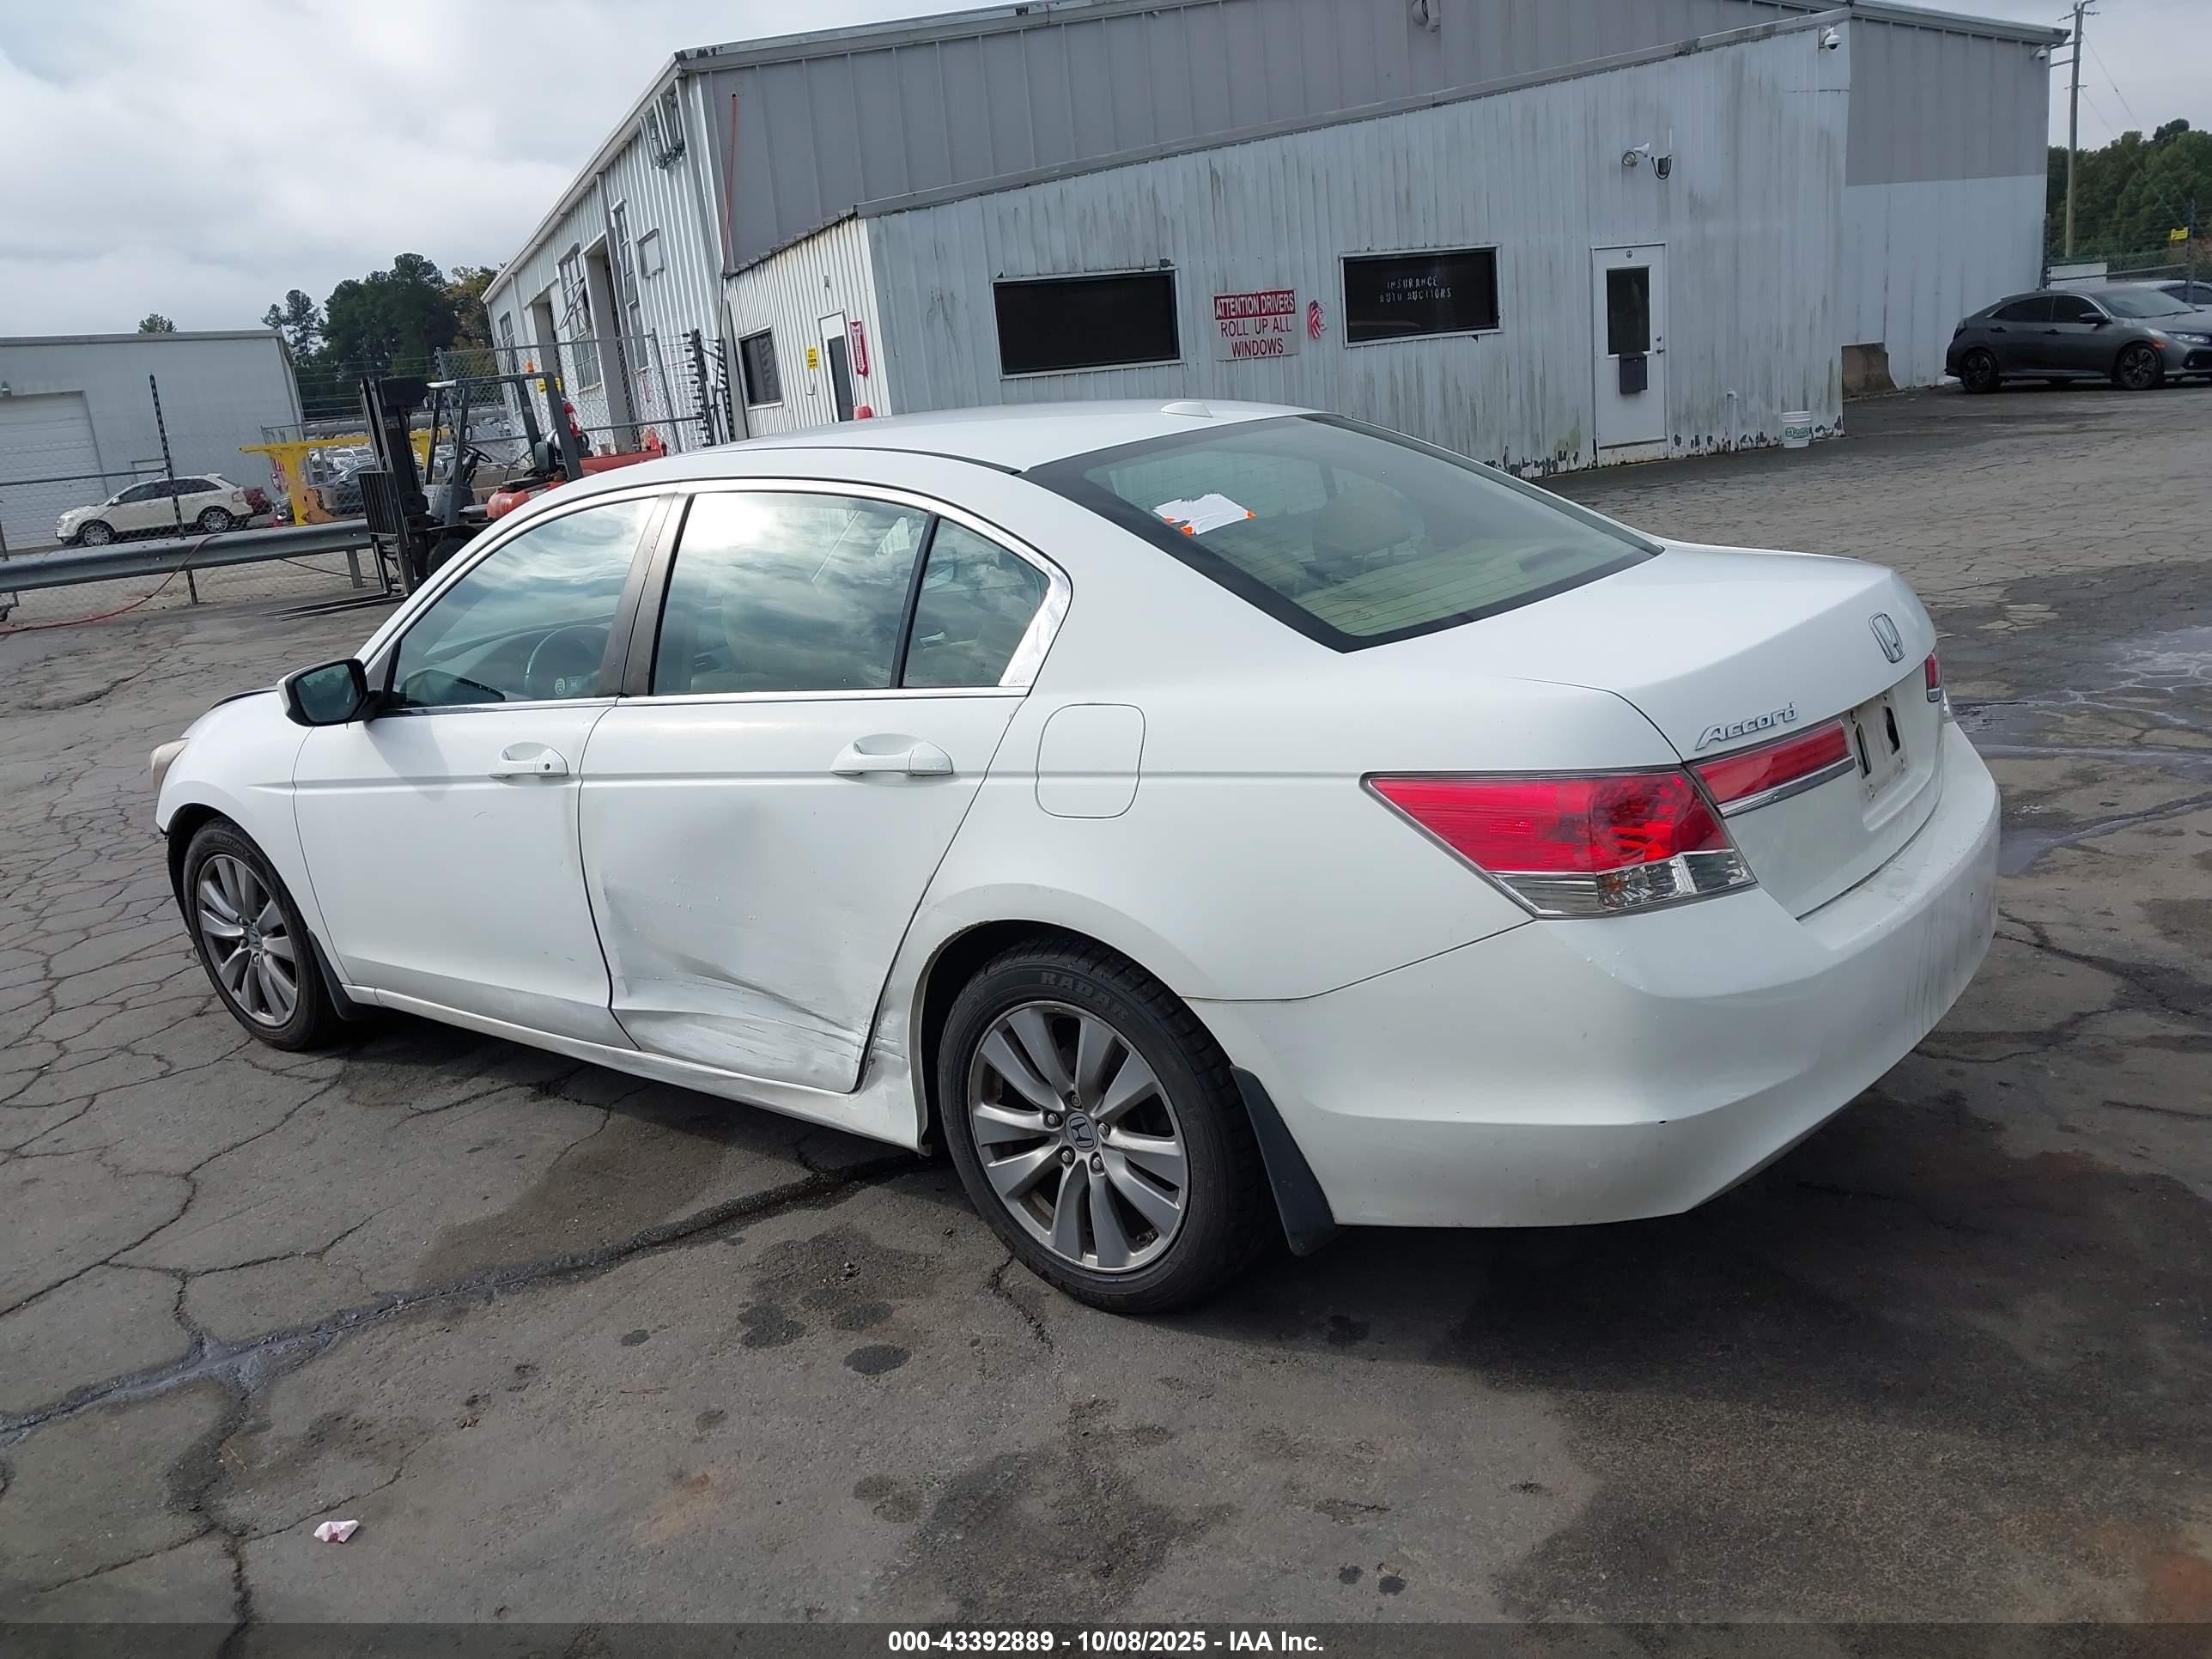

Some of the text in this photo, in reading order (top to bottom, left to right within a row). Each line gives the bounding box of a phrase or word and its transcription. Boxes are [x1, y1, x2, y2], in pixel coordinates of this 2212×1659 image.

[1387, 275, 1437, 289] INSURANCE
[1407, 287, 1451, 301] AUCTIONS
[1216, 293, 1294, 318] ATTENTION DRIVERS
[1220, 315, 1292, 337] ROLL UP ALL
[1231, 337, 1284, 358] WINDOWS
[1695, 701, 1799, 751] Accord
